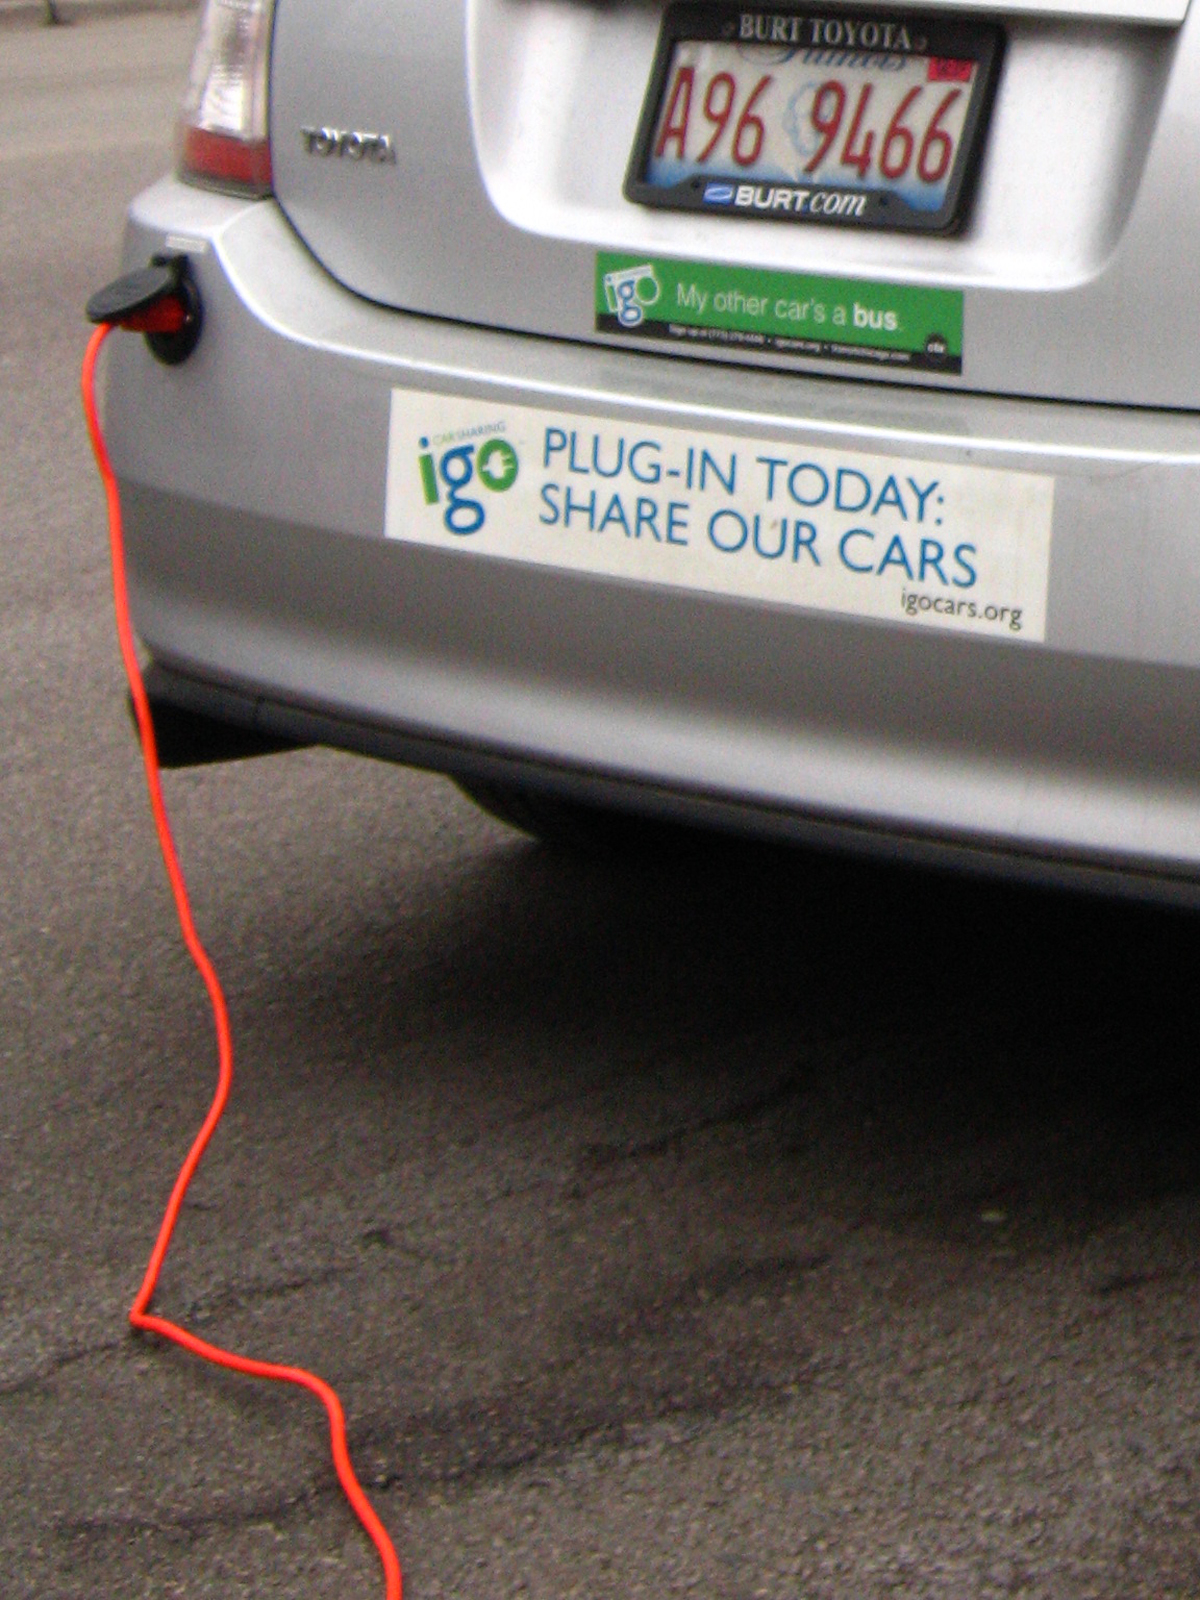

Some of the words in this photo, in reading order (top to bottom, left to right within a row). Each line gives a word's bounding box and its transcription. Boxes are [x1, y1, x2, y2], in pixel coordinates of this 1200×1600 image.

[739, 14, 799, 43] BURT
[809, 18, 911, 50] TOYOTA
[654, 66, 774, 166] A96
[803, 80, 963, 184] 9466
[677, 282, 707, 314] My
[713, 289, 768, 316] other
[774, 298, 825, 324] car's
[832, 306, 847, 326] a
[543, 426, 736, 495] PLUG-IN
[756, 455, 944, 527] TODAY:
[538, 482, 690, 547] SHARE
[707, 508, 822, 567] OUR
[838, 528, 978, 589] CARS
[900, 587, 1023, 630] igocars.org
